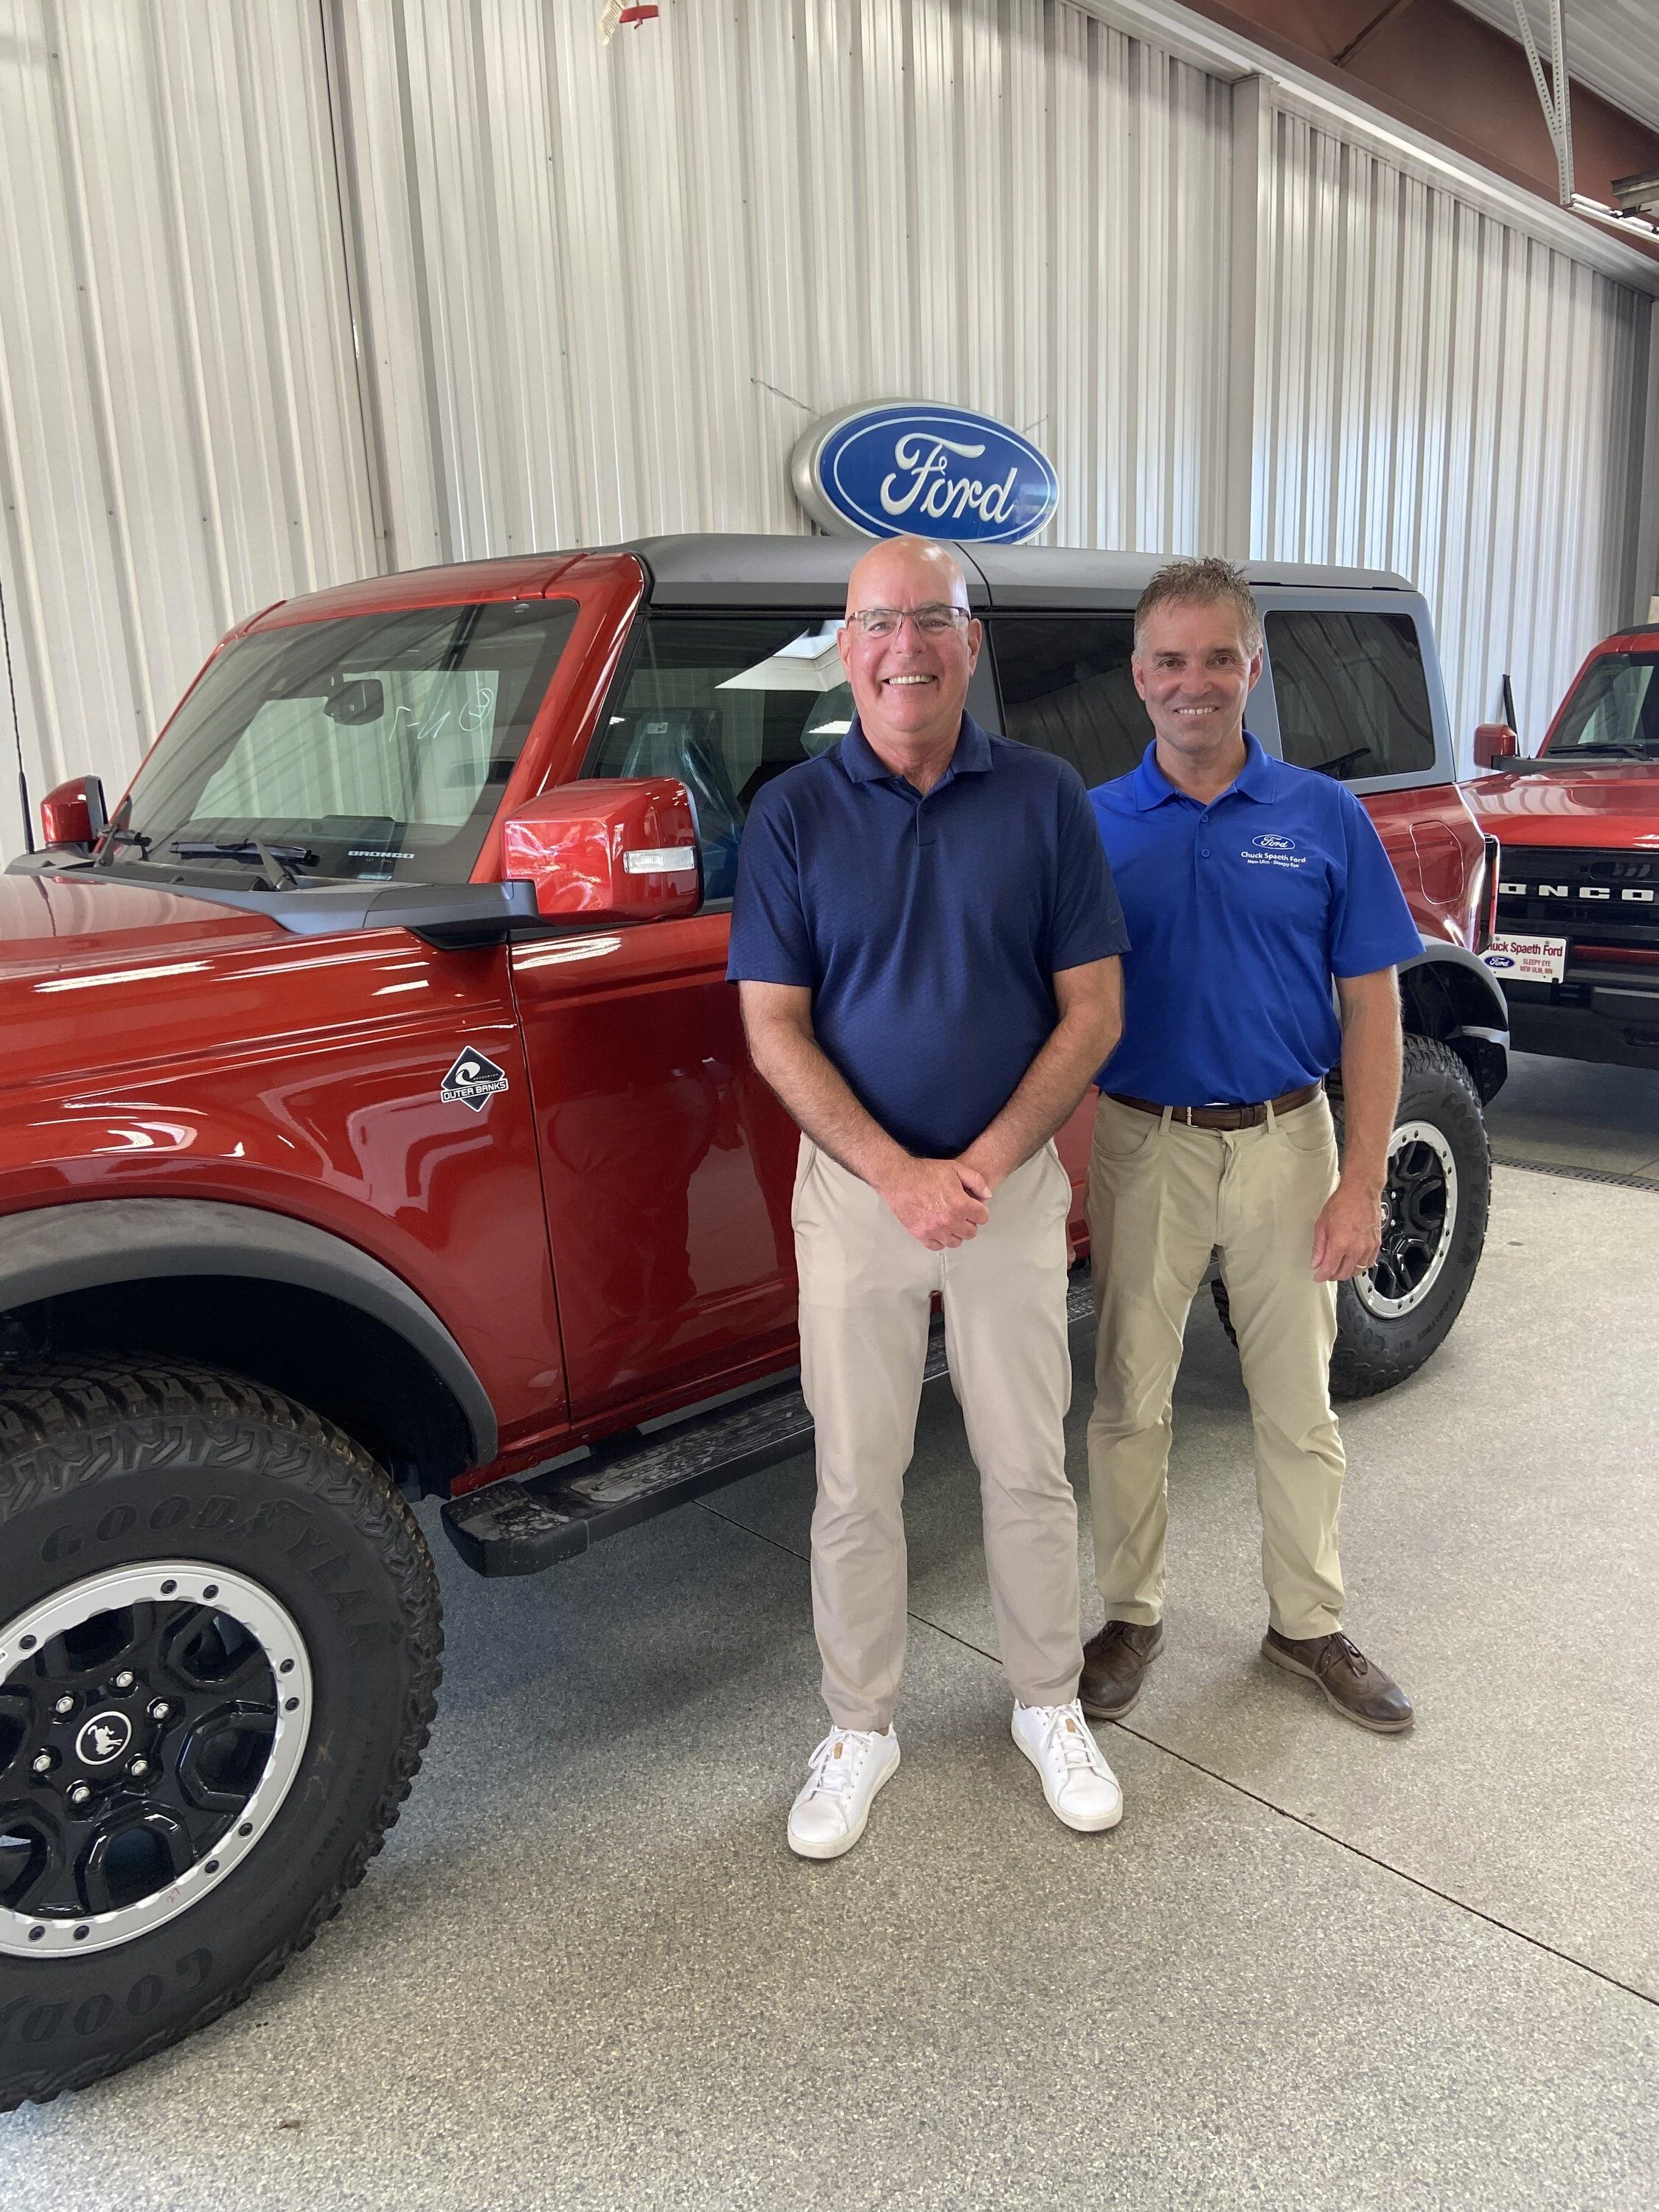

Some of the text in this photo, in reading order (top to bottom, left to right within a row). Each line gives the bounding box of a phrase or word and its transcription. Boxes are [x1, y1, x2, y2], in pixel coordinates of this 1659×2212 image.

[880, 432, 1018, 524] Ford
[1261, 836, 1288, 848] Ford
[348, 850, 414, 859] BRONCO
[1264, 852, 1289, 861] Spaeth
[1290, 855, 1307, 863] Ford
[1511, 942, 1541, 955] Spaeth
[1543, 945, 1563, 956] Ford
[1489, 957, 1510, 967] Ford
[1523, 958, 1541, 966] SLEEPY
[444, 1081, 506, 1099] OUTER BANKS
